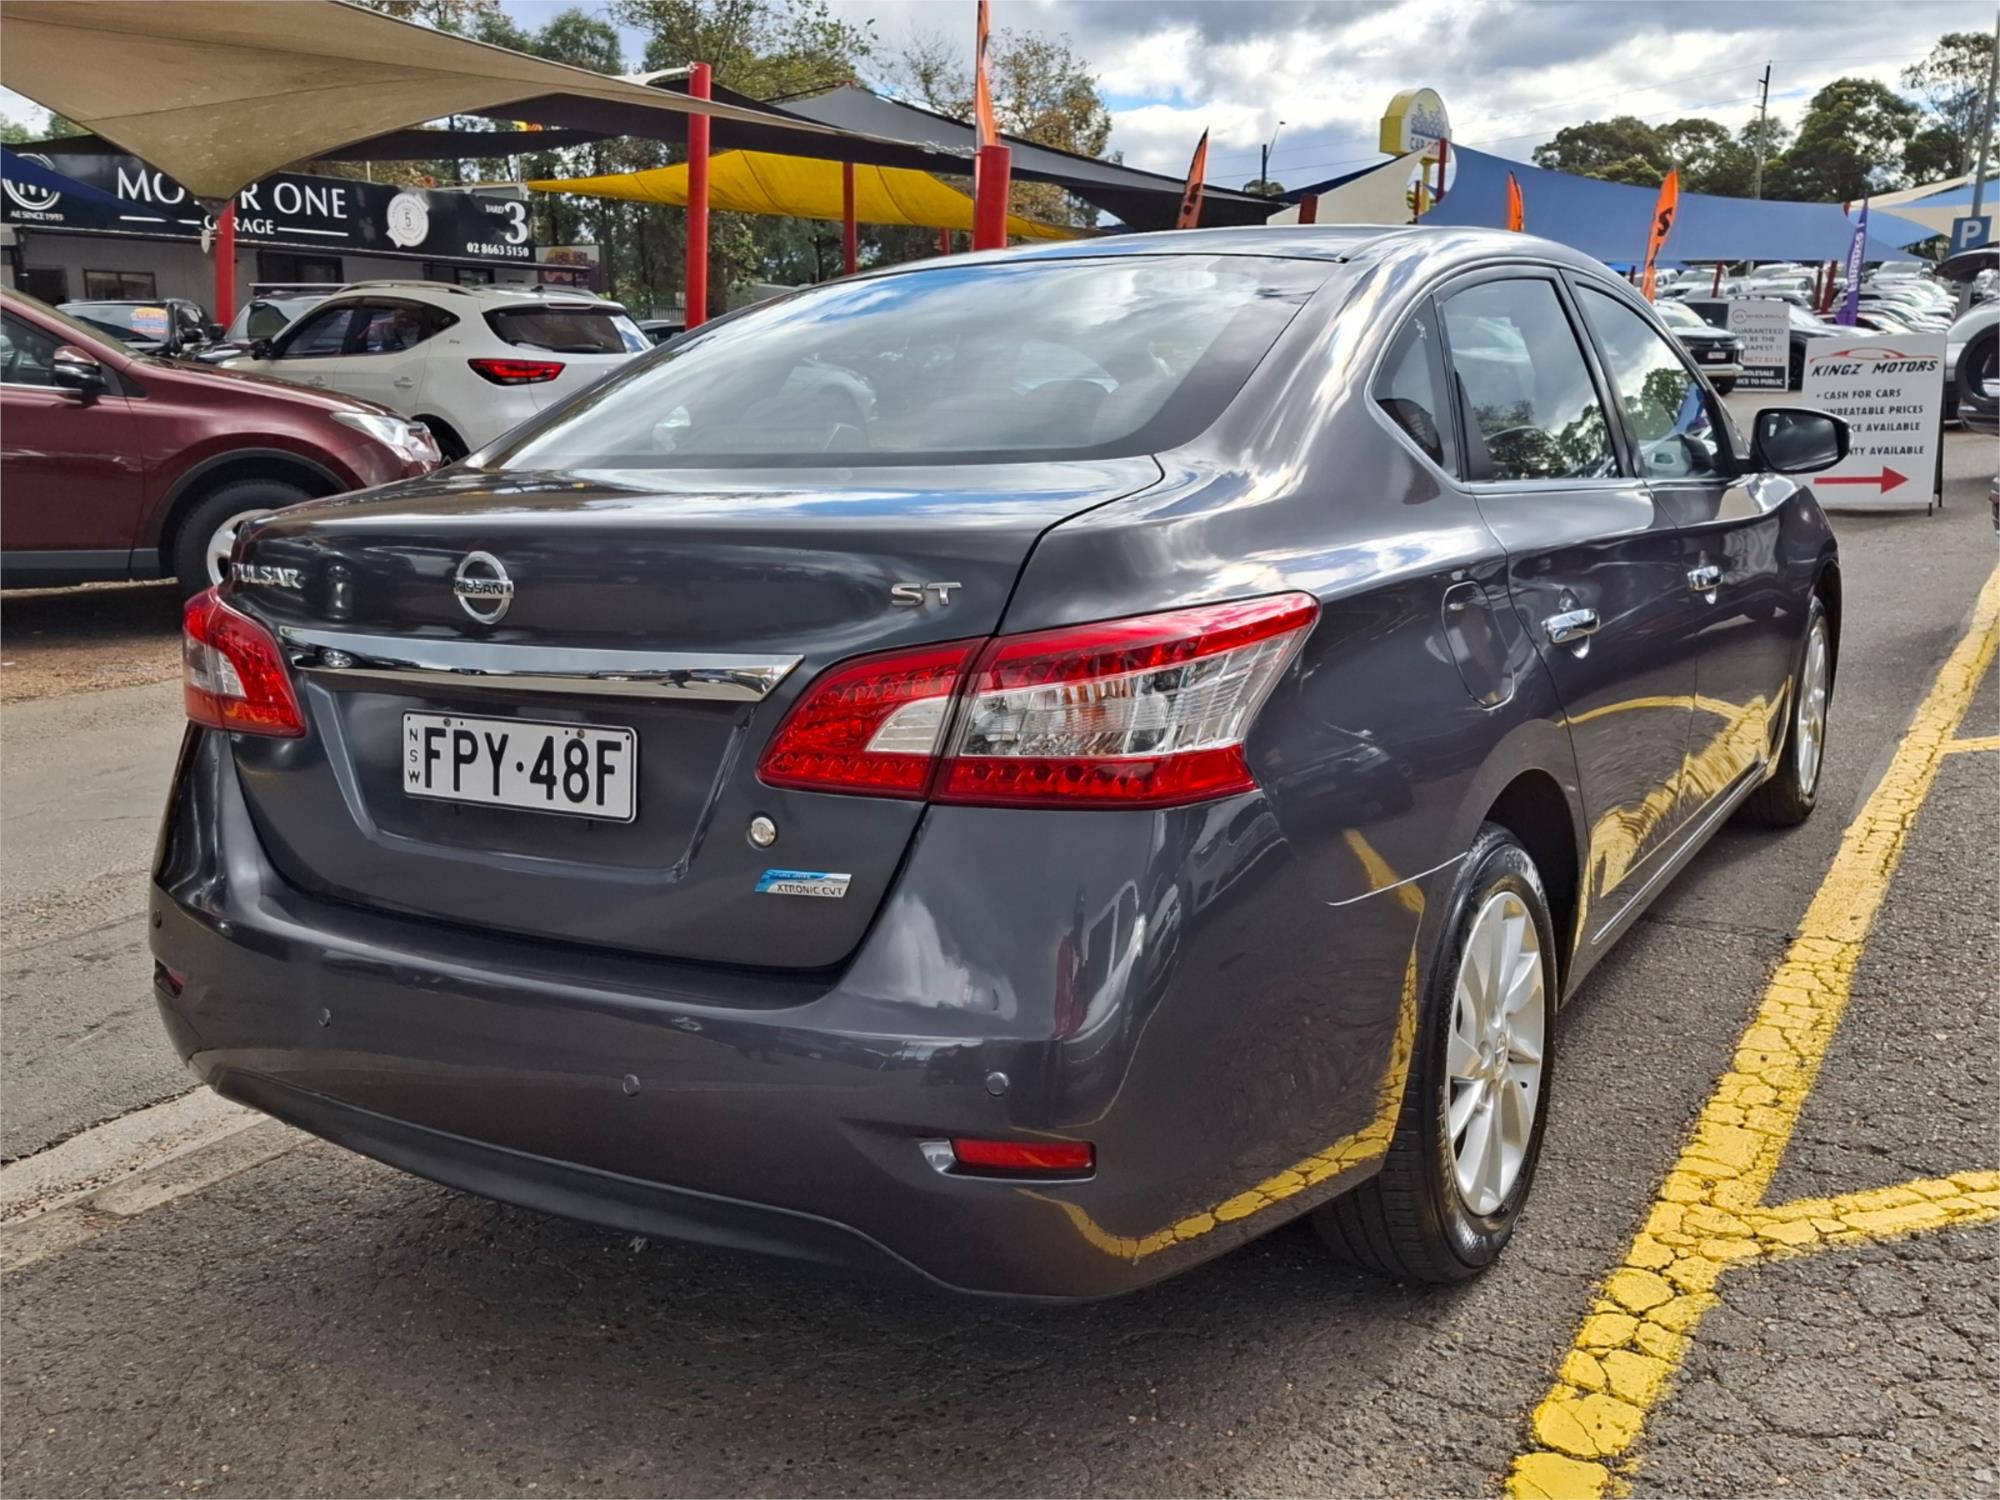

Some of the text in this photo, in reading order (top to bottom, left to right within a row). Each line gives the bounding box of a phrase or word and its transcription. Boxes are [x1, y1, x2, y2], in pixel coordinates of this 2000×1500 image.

[117, 166, 348, 219] MOR ONE
[204, 214, 275, 235] GRAGE
[504, 201, 528, 245] 3
[1960, 220, 1982, 248] P
[467, 242, 480, 254] 02
[481, 243, 505, 256] 8663
[506, 245, 530, 258] 5150
[1812, 360, 1938, 377] KINGZ MOTORS
[1824, 388, 1901, 400] CASH FOR CARS
[1889, 404, 1924, 414] PRICES
[1866, 422, 1921, 432] AVAILABLE
[1869, 445, 1925, 455] AVAILABLE
[232, 562, 302, 589] PULSAR
[455, 580, 504, 595] NISSAN
[891, 582, 962, 607] ST
[776, 884, 843, 896] XTRONIC CVT
